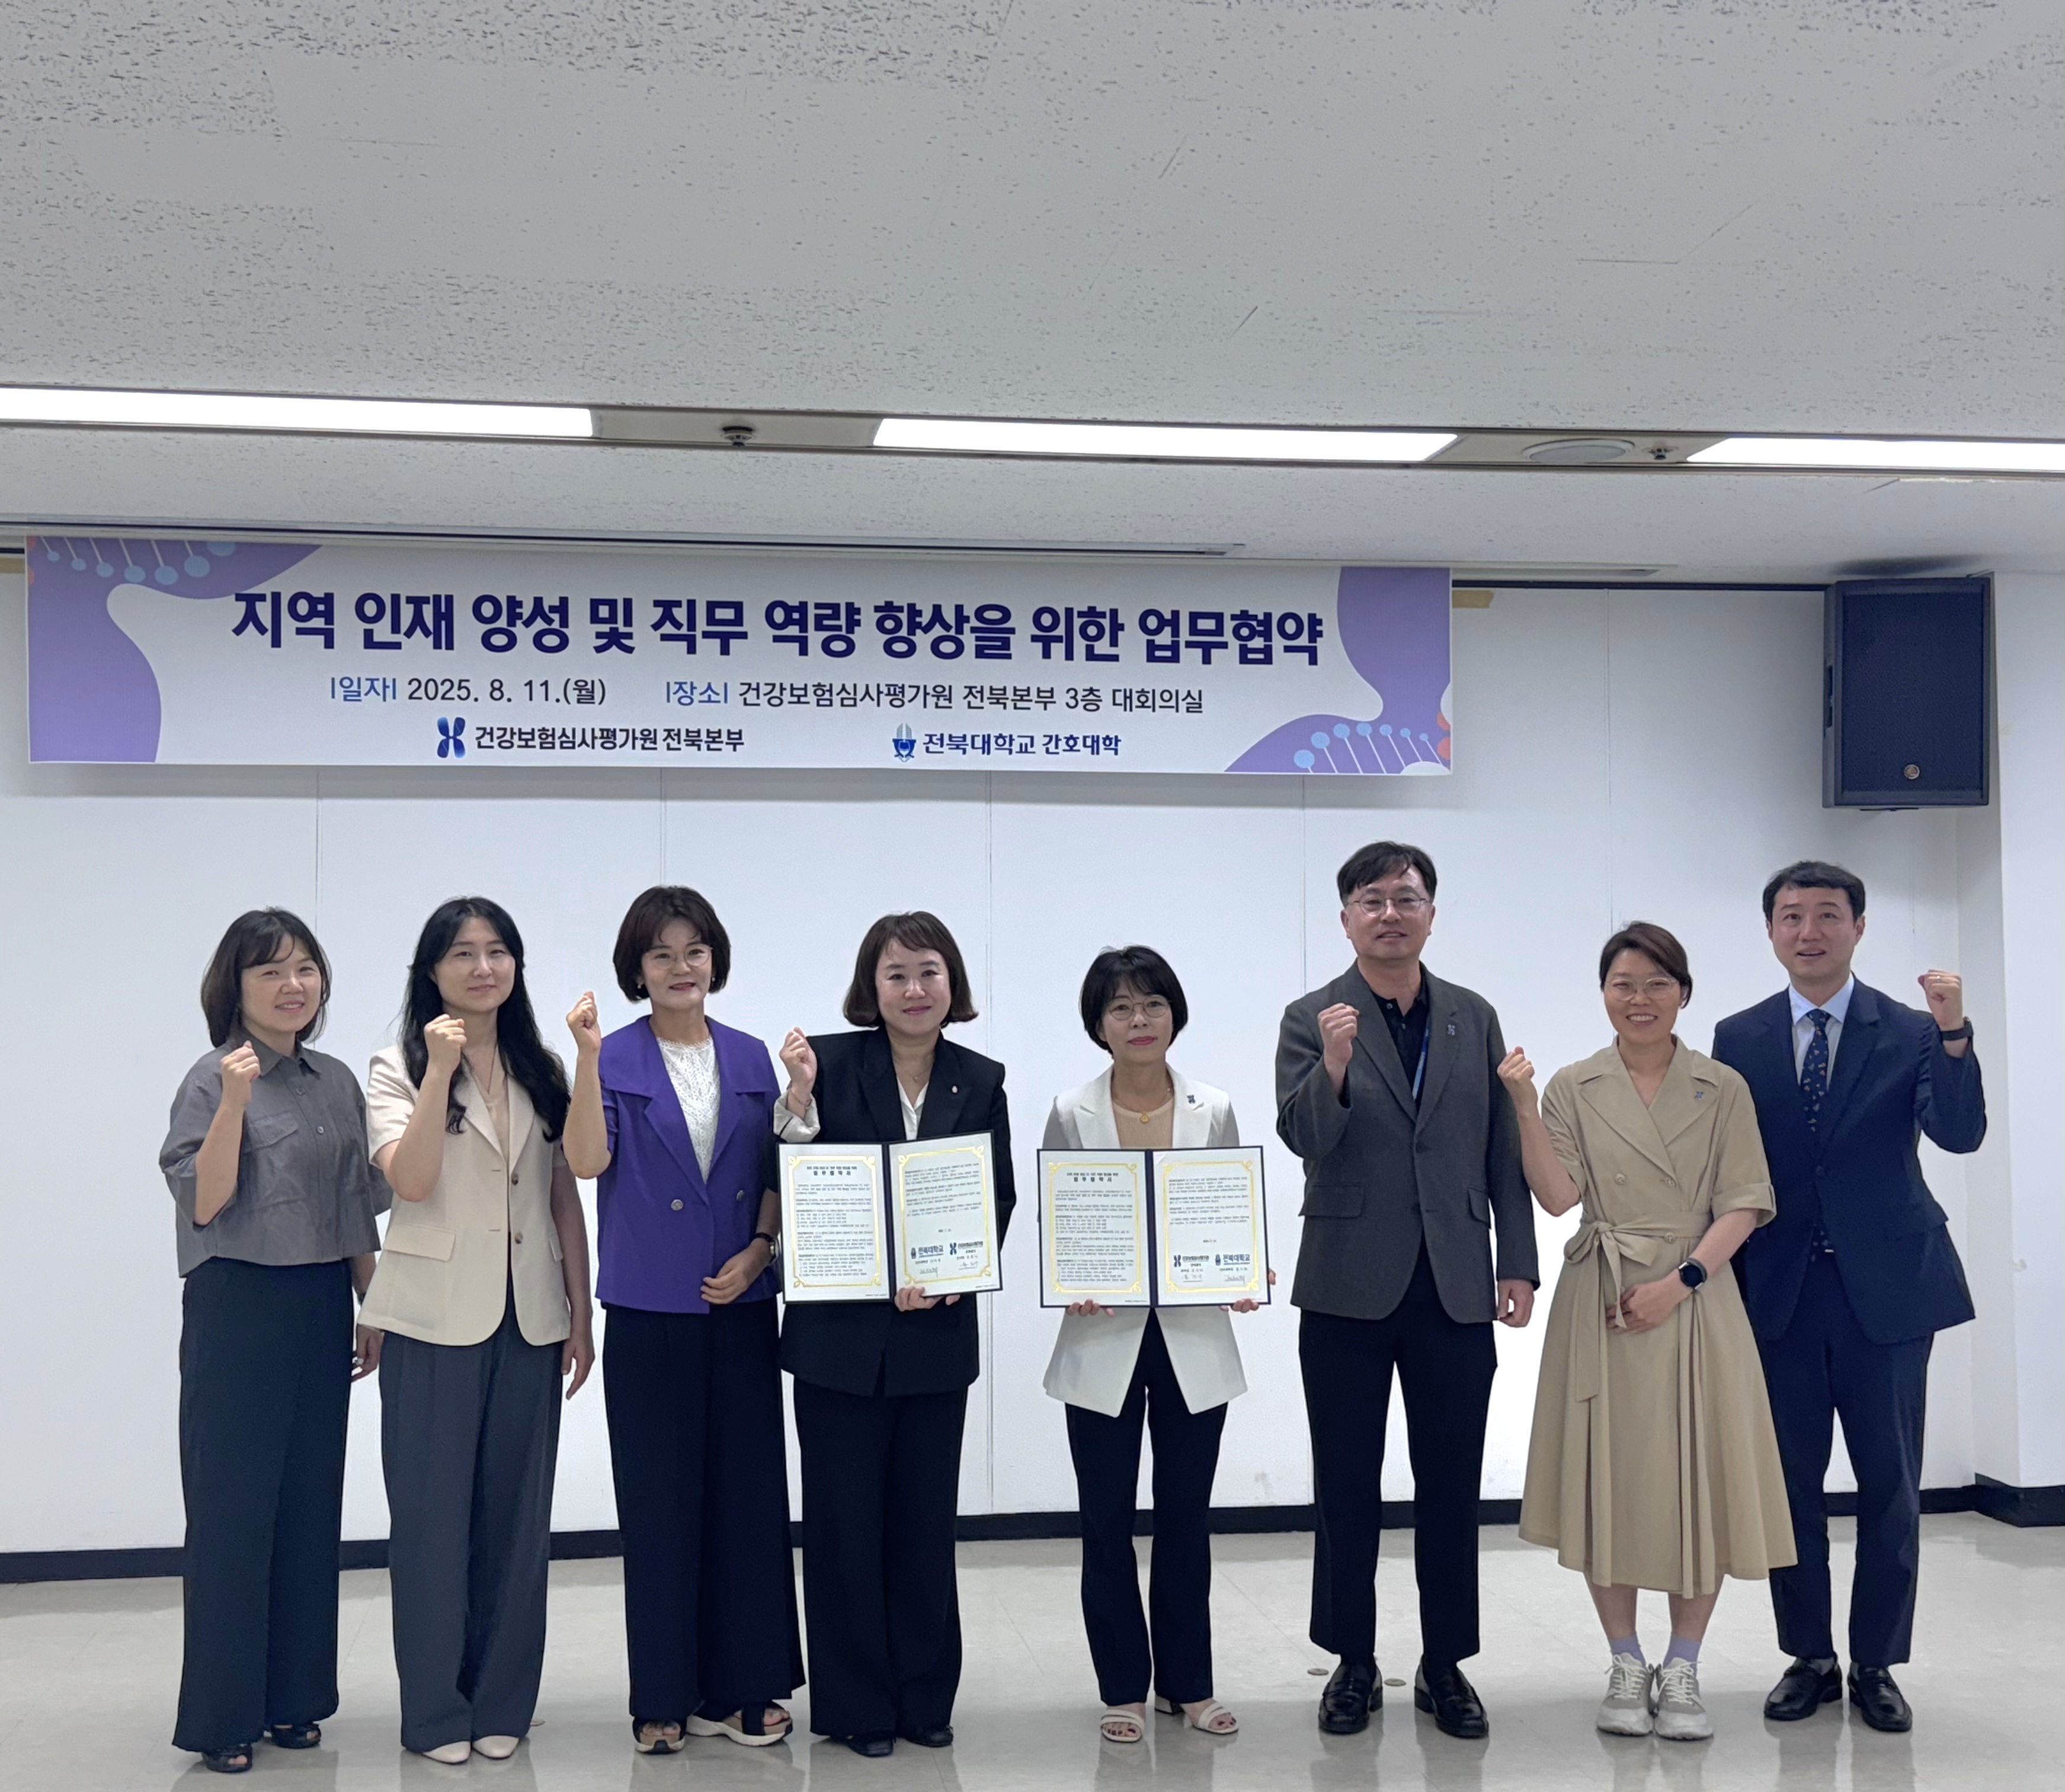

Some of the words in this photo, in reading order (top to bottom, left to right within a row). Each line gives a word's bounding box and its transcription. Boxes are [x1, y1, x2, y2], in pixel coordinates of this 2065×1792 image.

[232, 591, 334, 649] 지역
[355, 593, 454, 650] 인재
[472, 594, 569, 653] 양성
[590, 598, 635, 654] 및
[651, 599, 748, 655] 직무
[765, 600, 861, 658] 역량
[874, 601, 1016, 660] 향상을
[1030, 606, 1125, 662] 위한
[1139, 609, 1323, 665] 업무협약
[408, 678, 478, 702] 2025.
[489, 679, 511, 702] 8.
[524, 678, 606, 705] 11.(월)
[739, 682, 952, 709] 건강보험심사평가원
[963, 686, 1056, 711] 전북본부
[1065, 687, 1102, 712] 3층
[1112, 688, 1203, 713] 대회의실
[475, 727, 657, 750] 건강보험심사평가원
[662, 728, 744, 751] 전북본부
[923, 733, 1036, 756] 전북대학교
[1042, 734, 1121, 756] 간호대학
